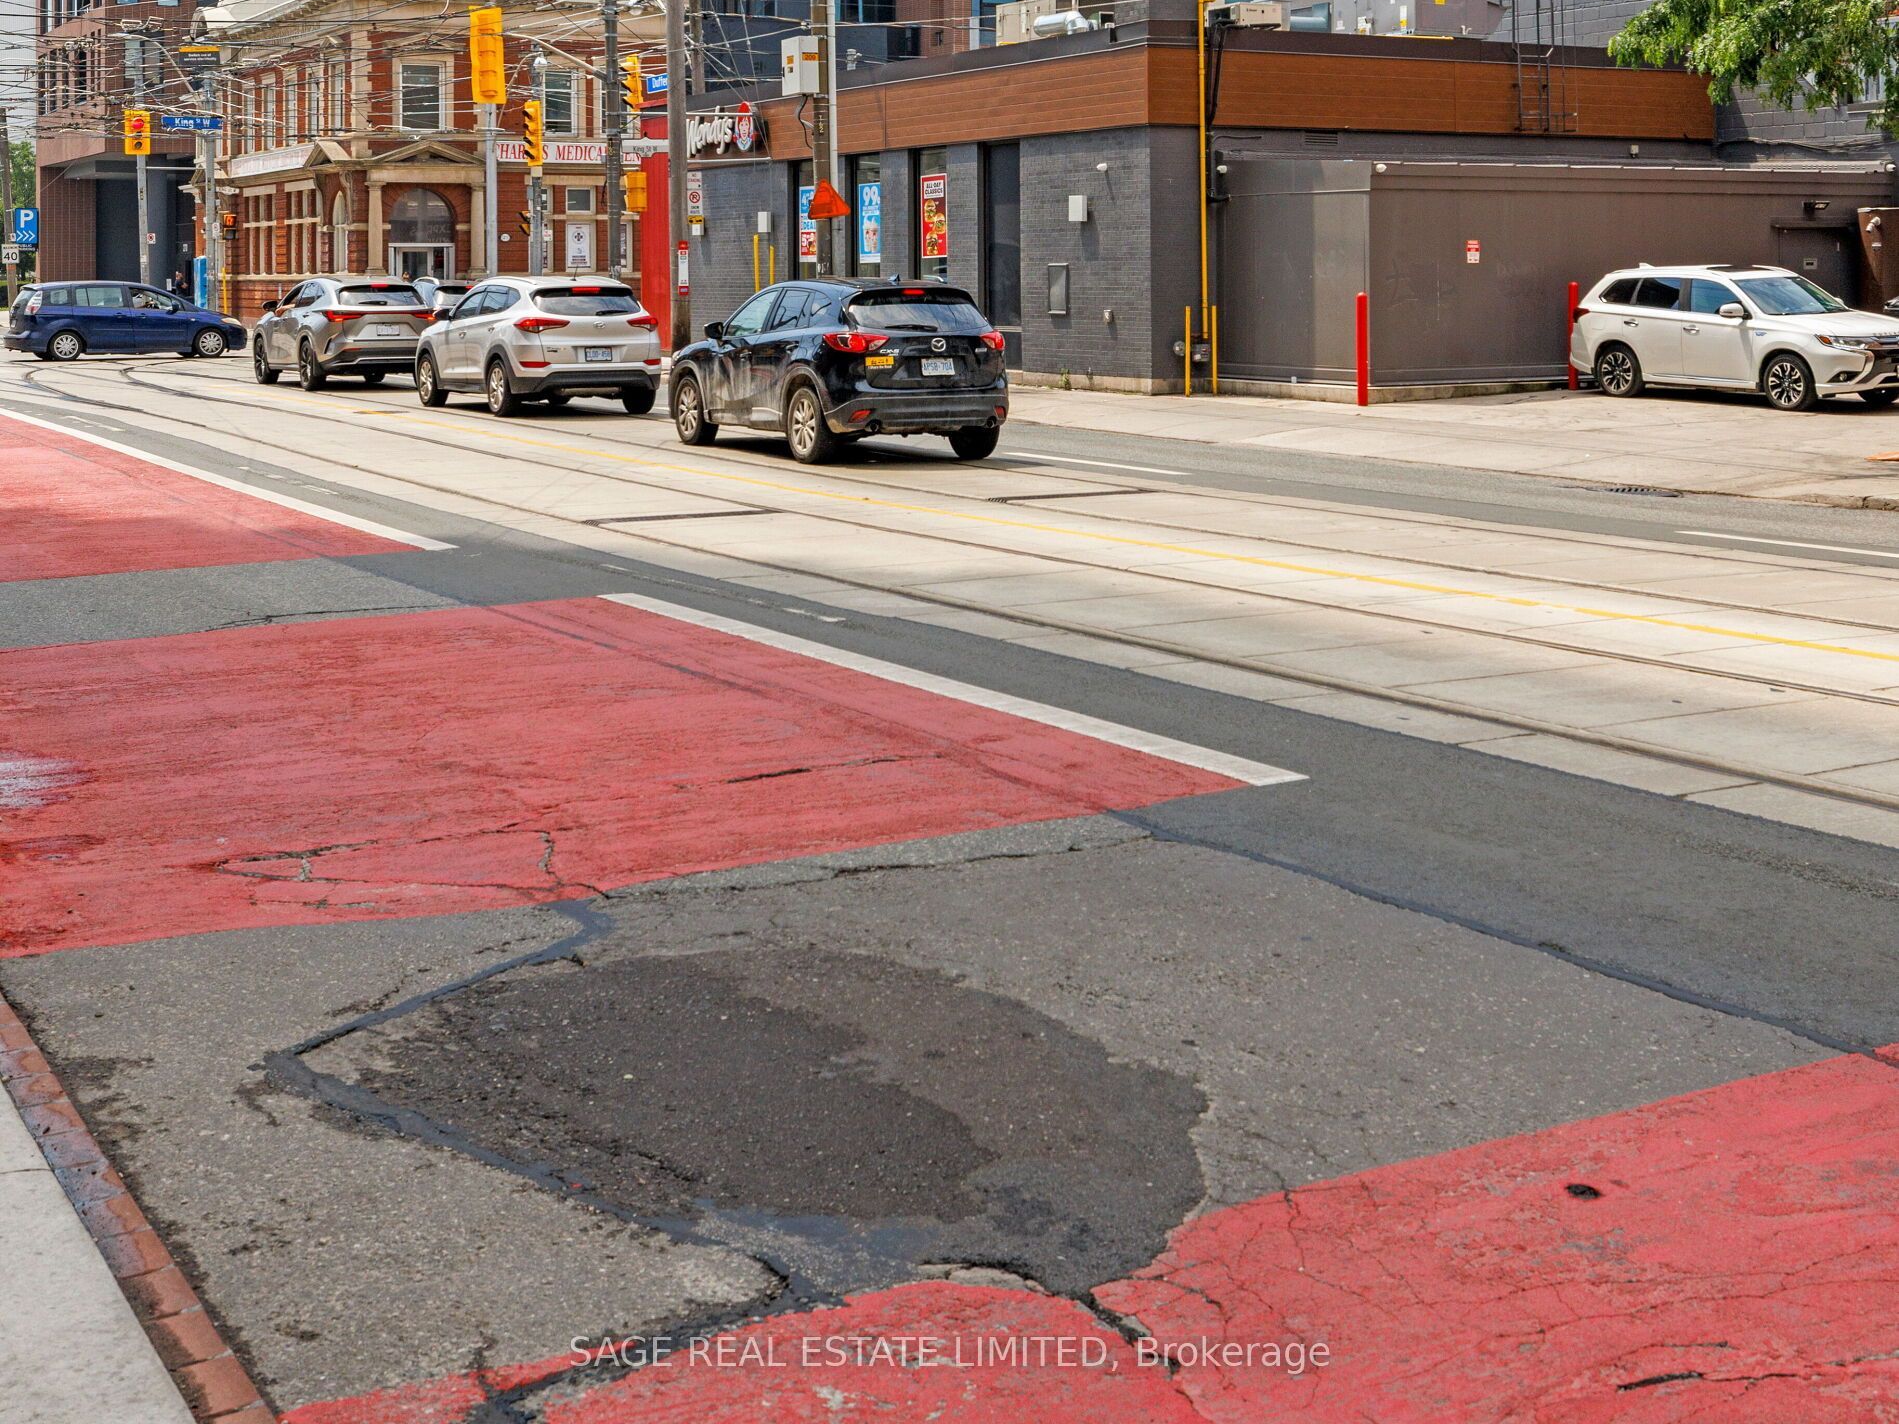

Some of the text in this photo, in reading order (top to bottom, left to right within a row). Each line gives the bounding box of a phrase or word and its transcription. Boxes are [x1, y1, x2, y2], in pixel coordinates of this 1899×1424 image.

[174, 118, 194, 128] King
[202, 118, 210, 128] W
[686, 106, 733, 158] Wendy's
[555, 144, 608, 162] MEDICA
[20, 210, 34, 228] P
[4, 252, 18, 260] 40
